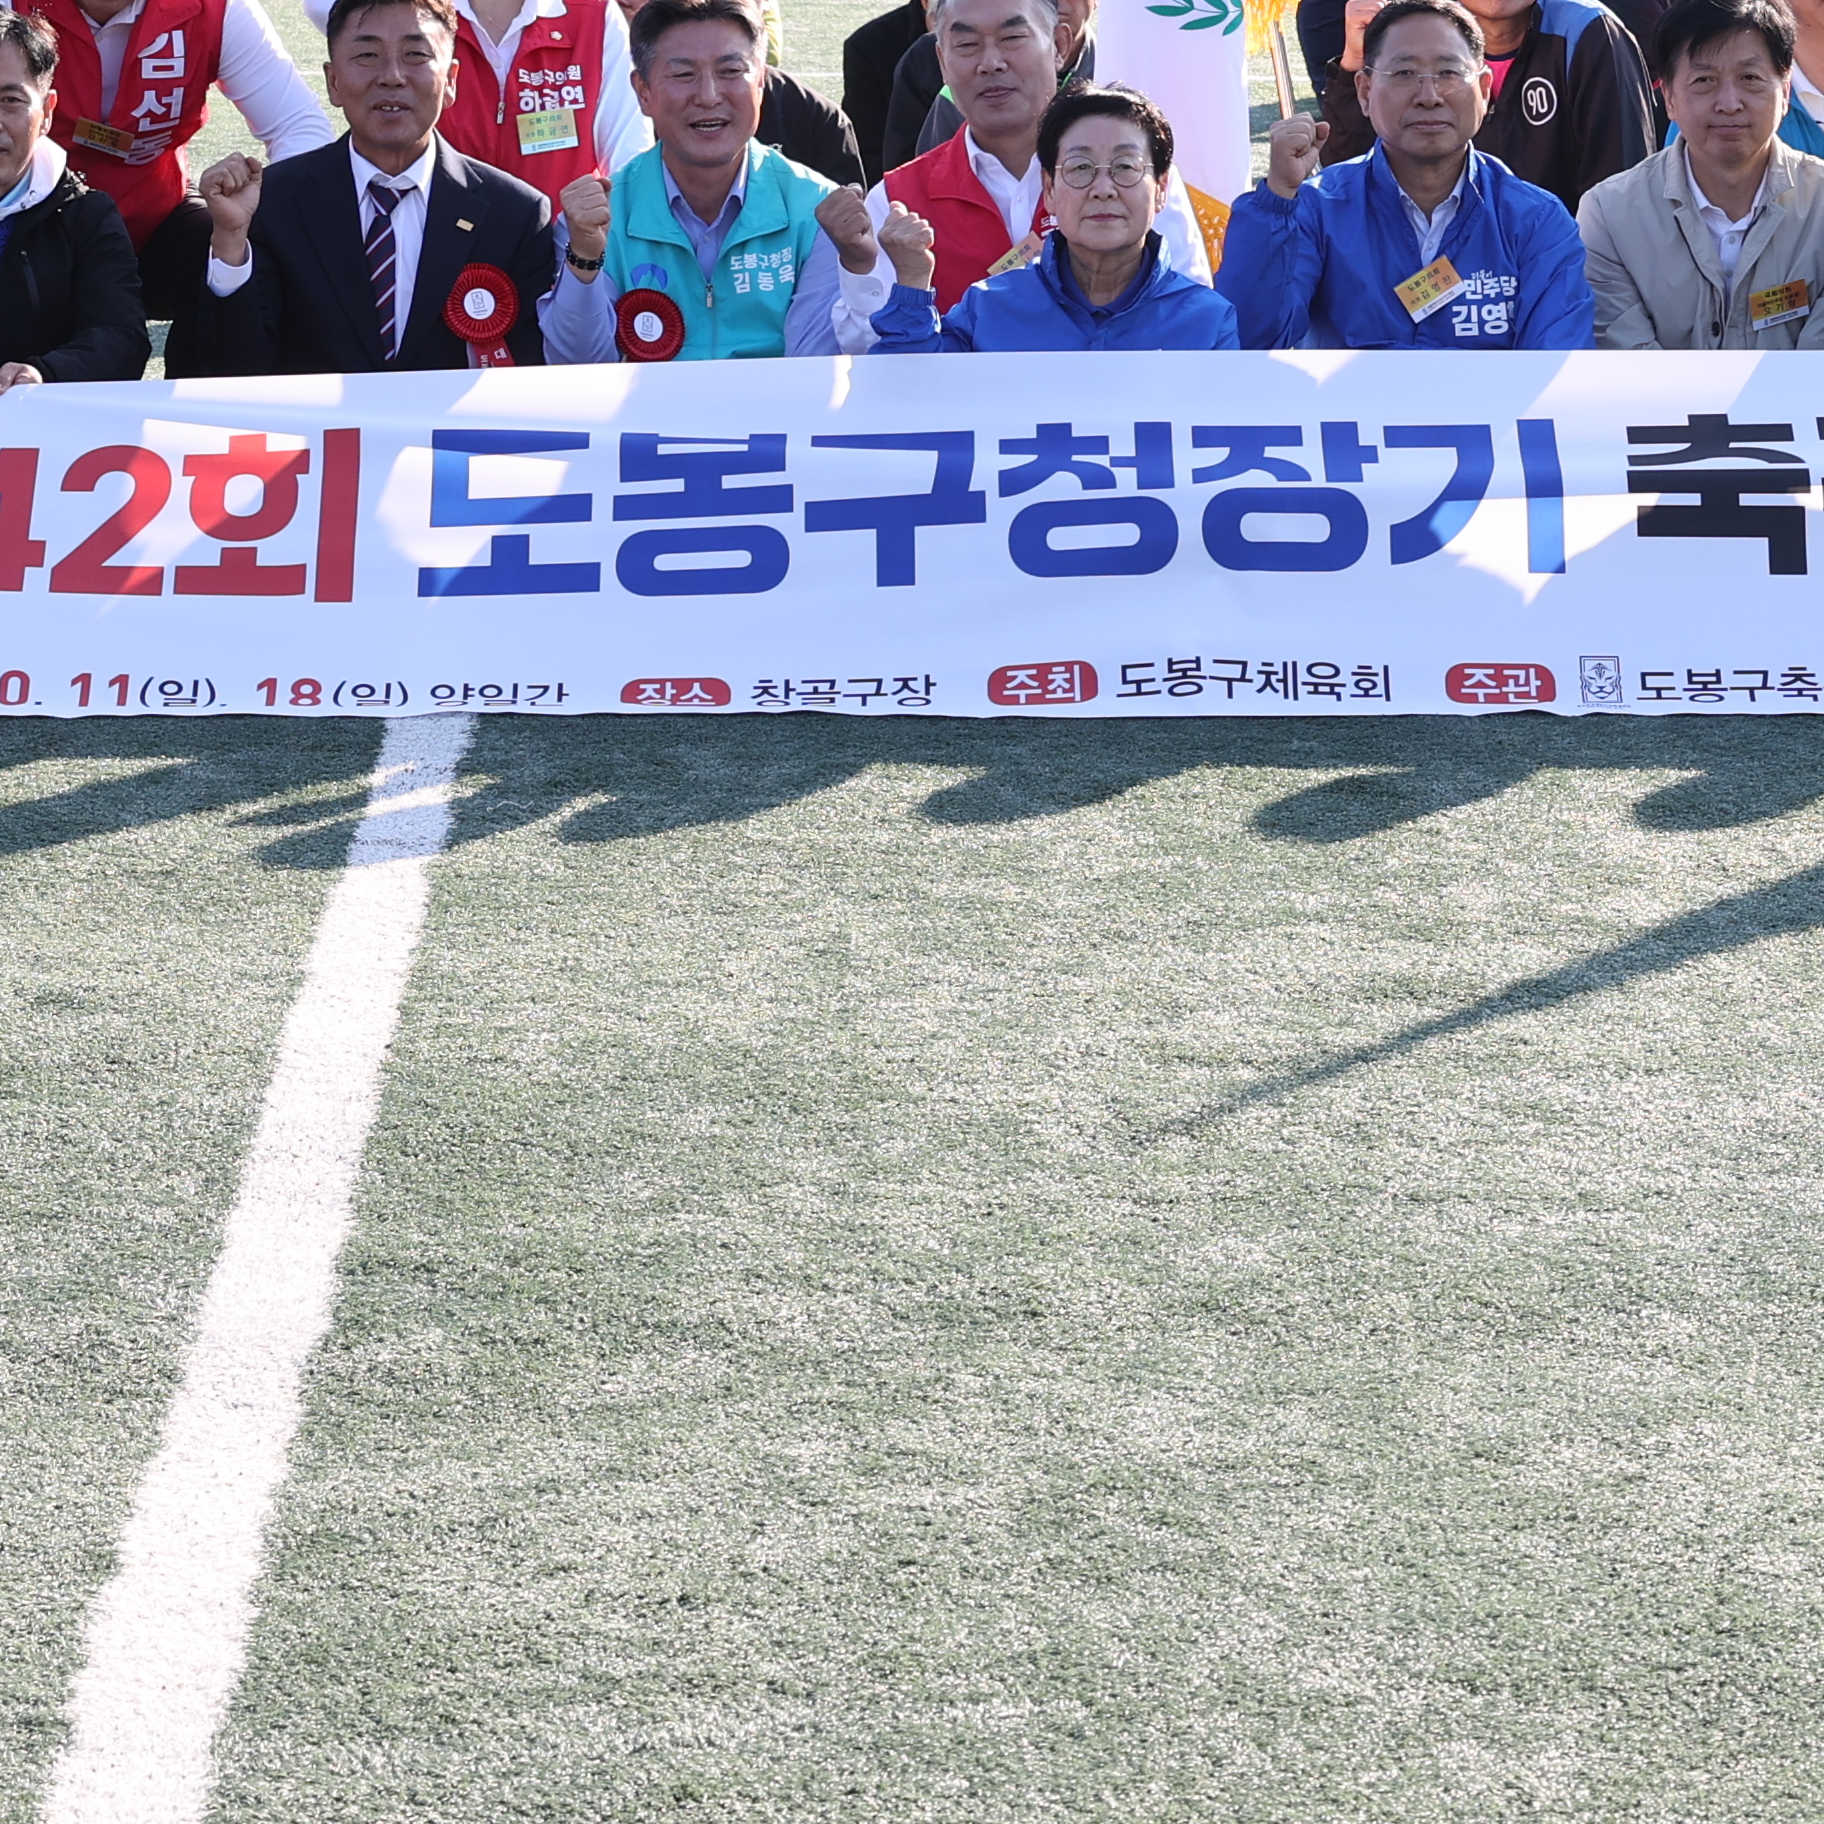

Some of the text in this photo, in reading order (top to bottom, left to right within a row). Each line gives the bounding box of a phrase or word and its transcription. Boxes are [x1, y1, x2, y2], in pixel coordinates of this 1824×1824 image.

[518, 64, 582, 86] 도봉구의원
[1527, 87, 1548, 115] 90
[730, 246, 792, 271] 도봉구청장
[733, 264, 795, 294] 김동욱
[1463, 276, 1518, 300] 민주당
[1452, 301, 1514, 337] 김영
[417, 418, 1567, 598] 도봉구청장기
[256, 676, 409, 709] 18(일)
[428, 681, 569, 709] 양일간
[635, 682, 718, 707] 장소
[748, 672, 938, 709] 창골구장
[1001, 664, 1089, 705] 주최
[1114, 656, 1392, 703] 도봉구체육회
[1458, 666, 1543, 705] 주관
